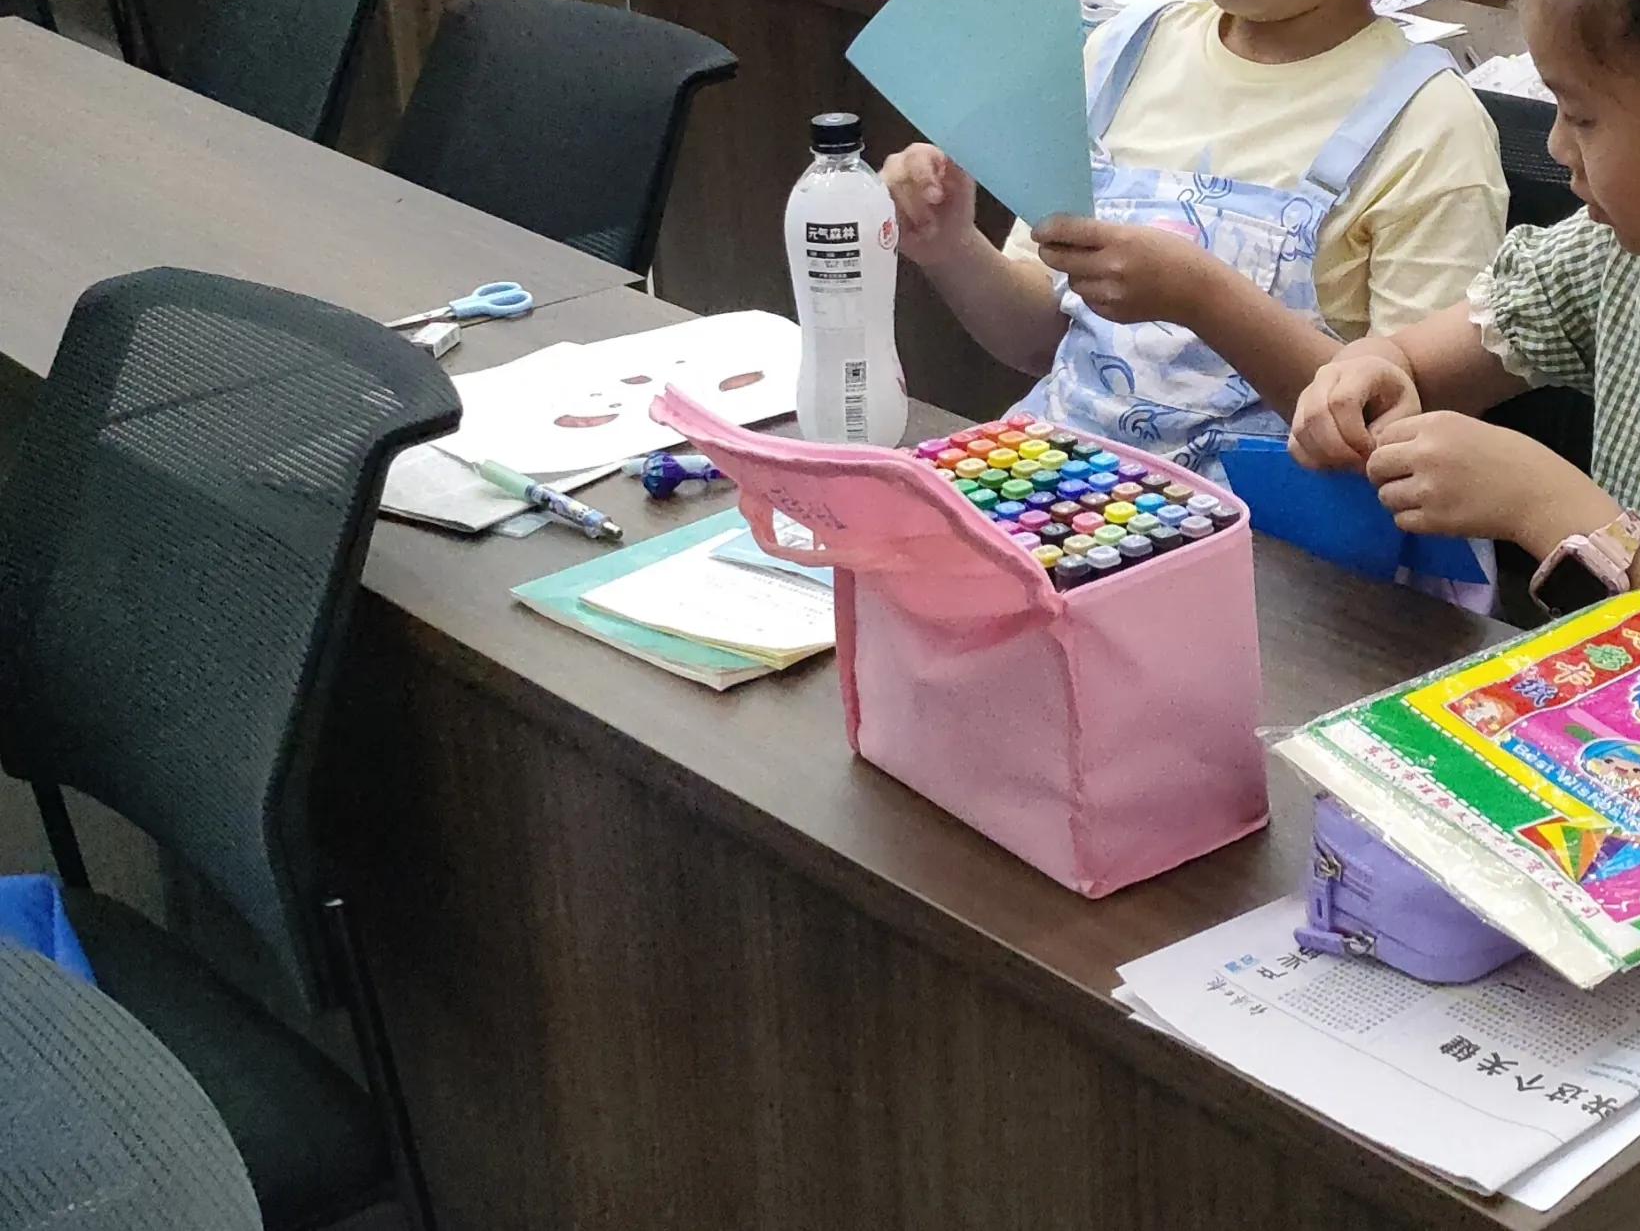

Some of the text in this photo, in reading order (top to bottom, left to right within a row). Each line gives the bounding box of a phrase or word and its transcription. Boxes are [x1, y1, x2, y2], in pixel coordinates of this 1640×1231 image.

[808, 226, 856, 241] 元气森林
[1511, 741, 1557, 777] Best
